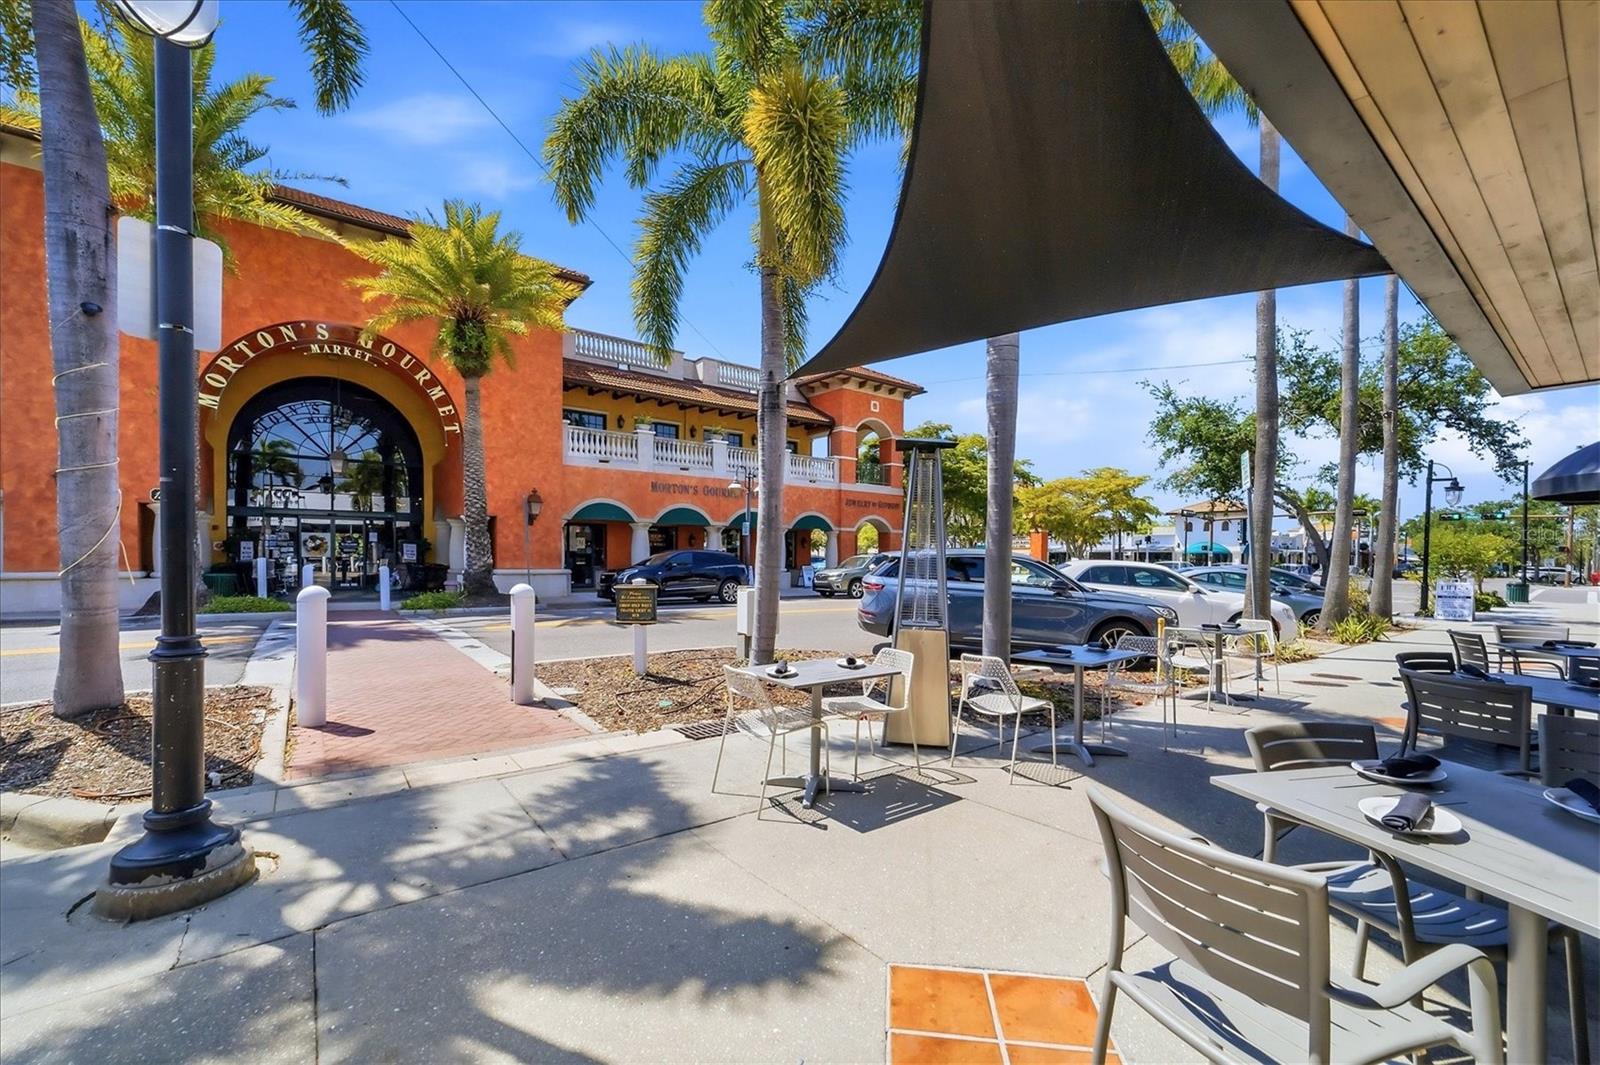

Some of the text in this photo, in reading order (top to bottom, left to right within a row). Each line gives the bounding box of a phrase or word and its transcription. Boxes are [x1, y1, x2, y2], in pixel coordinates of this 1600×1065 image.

[310, 343, 373, 362] MARKET
[198, 323, 461, 434] MORTON'S GOURMET
[651, 481, 699, 496] MORTON'S
